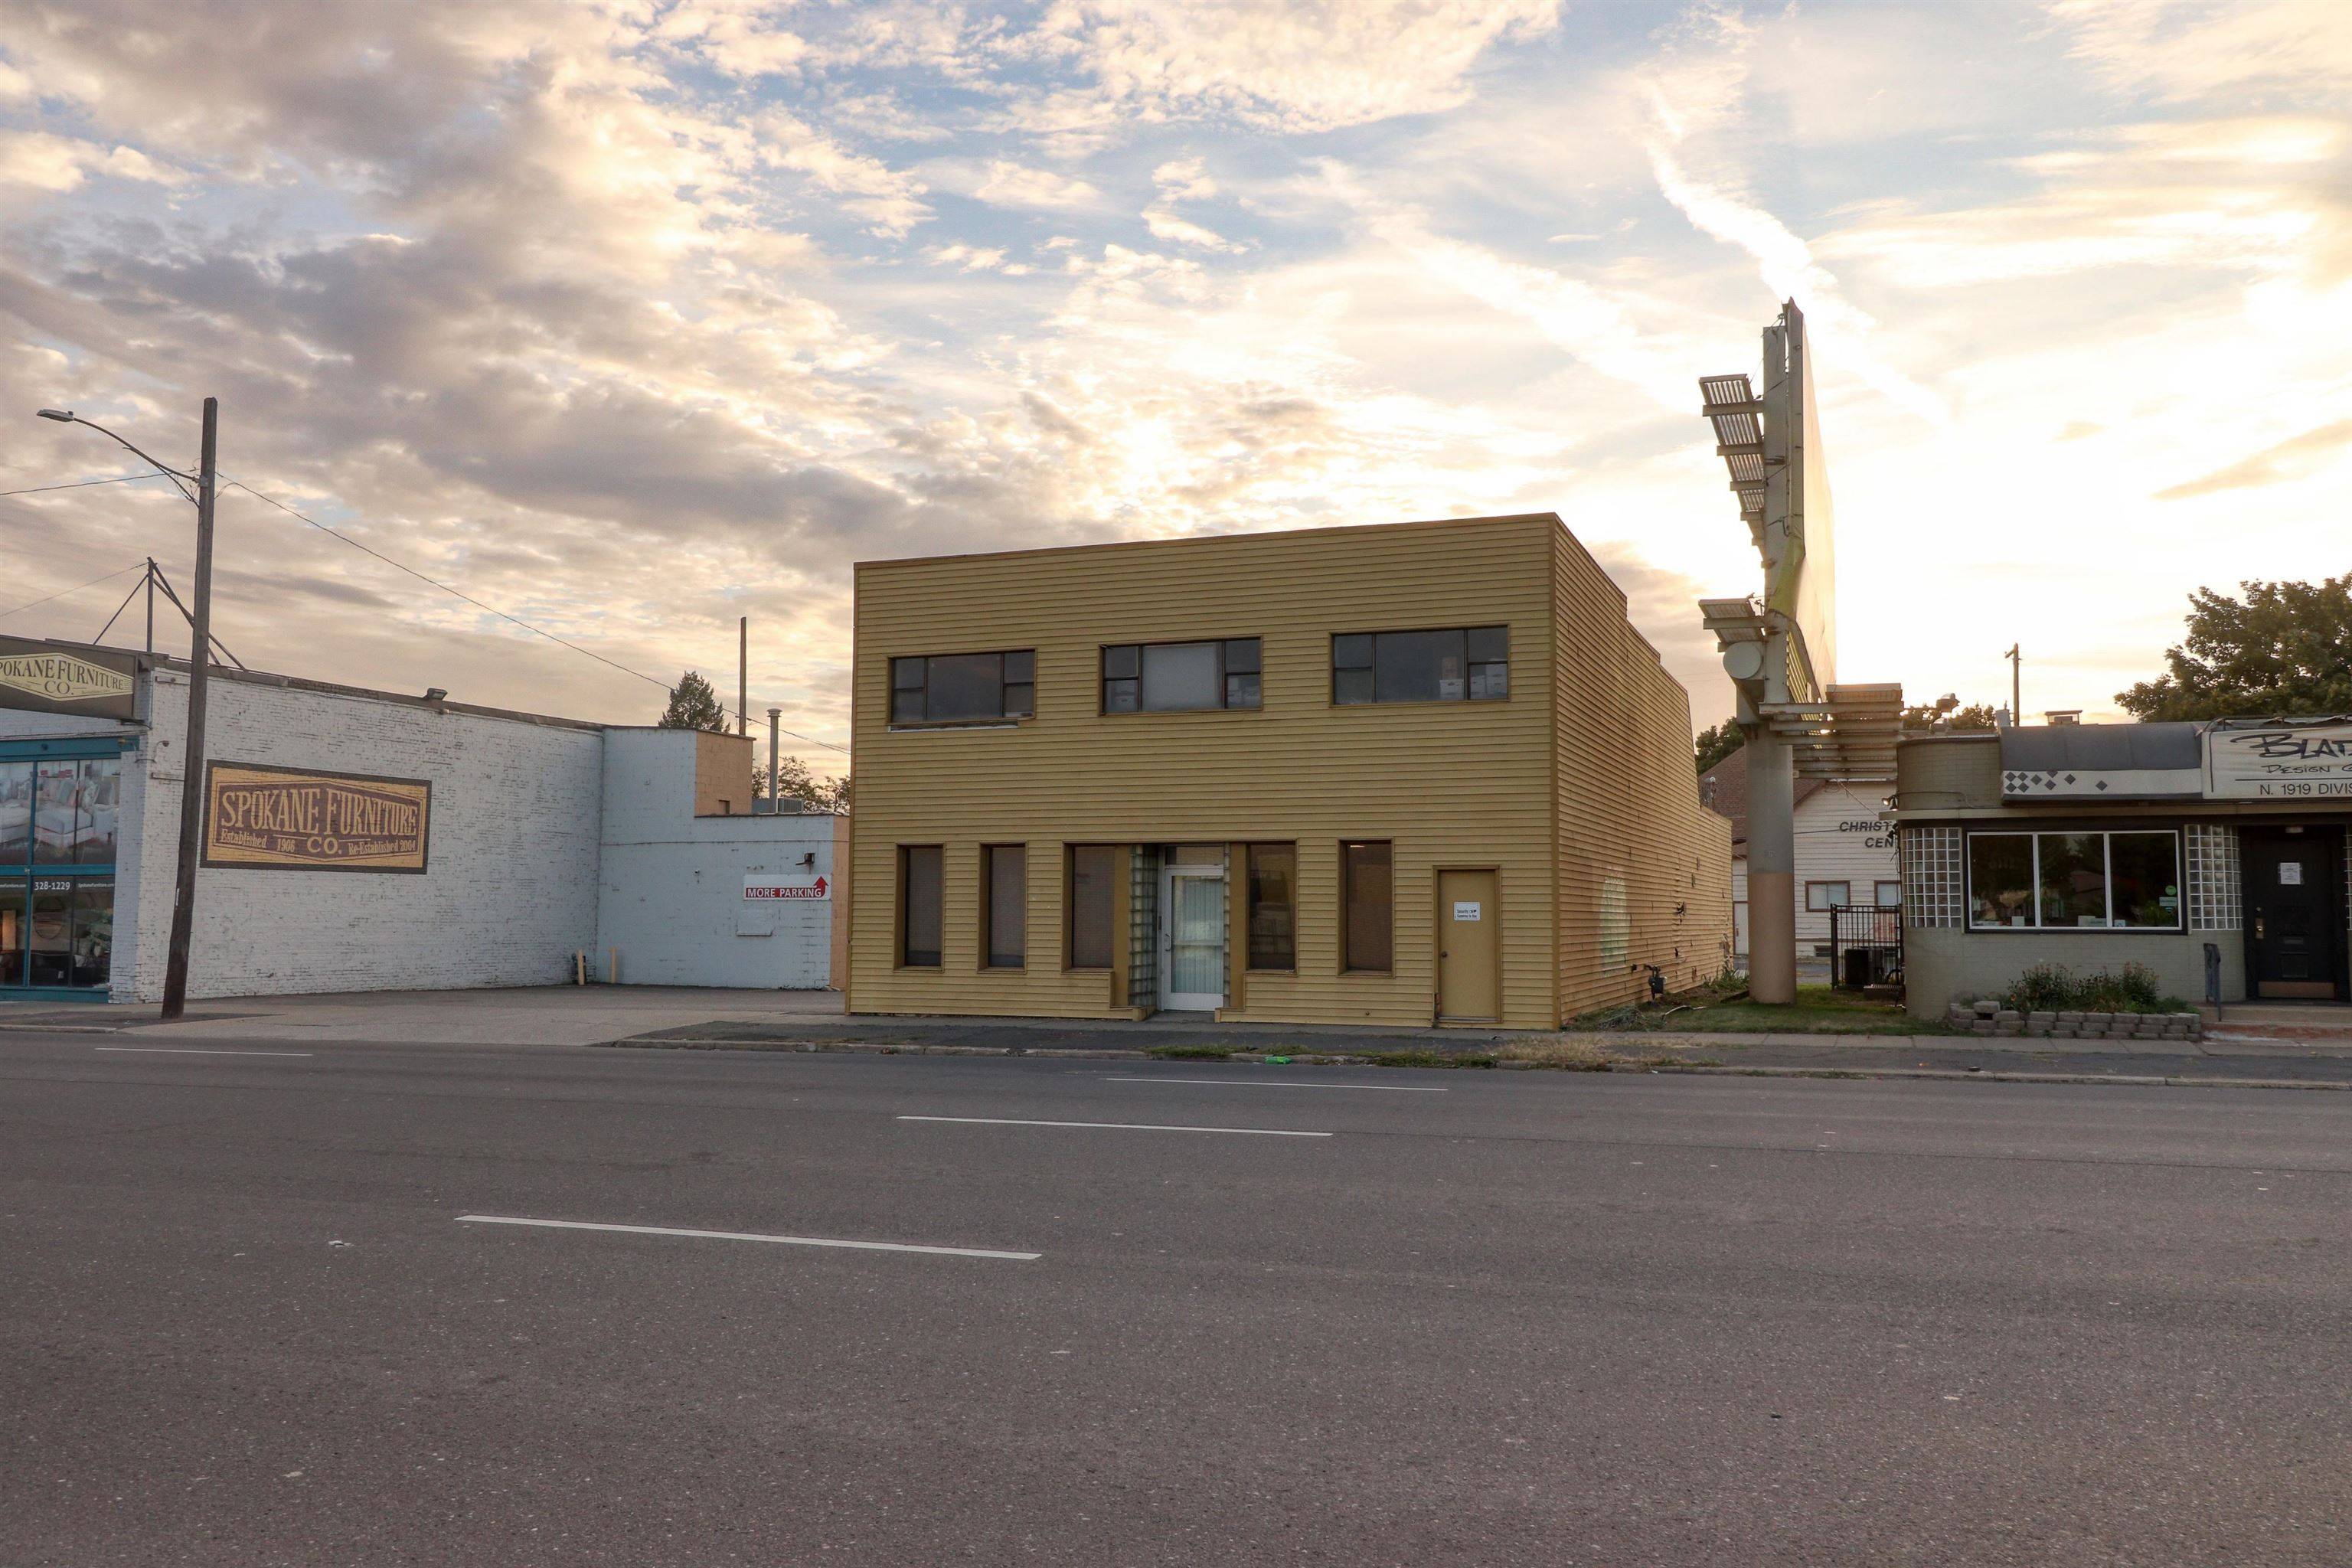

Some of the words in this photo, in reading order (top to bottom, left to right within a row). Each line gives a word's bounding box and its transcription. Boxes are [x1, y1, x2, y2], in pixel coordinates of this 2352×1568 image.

[57, 660, 123, 690] FURNITURE
[44, 681, 74, 695] CO.
[2230, 733, 2352, 760] BLAT
[2260, 784, 2273, 795] N.
[2282, 783, 2311, 795] 1919
[221, 788, 320, 834] SPOKANE
[324, 788, 418, 836] FURNITURE
[220, 828, 267, 849] Established
[307, 837, 342, 854] CO.
[348, 840, 399, 856] Re-Established
[400, 840, 416, 852] 2004
[34, 881, 70, 891] 328-1229
[747, 888, 776, 897] MORE
[779, 888, 822, 897] PARKING
